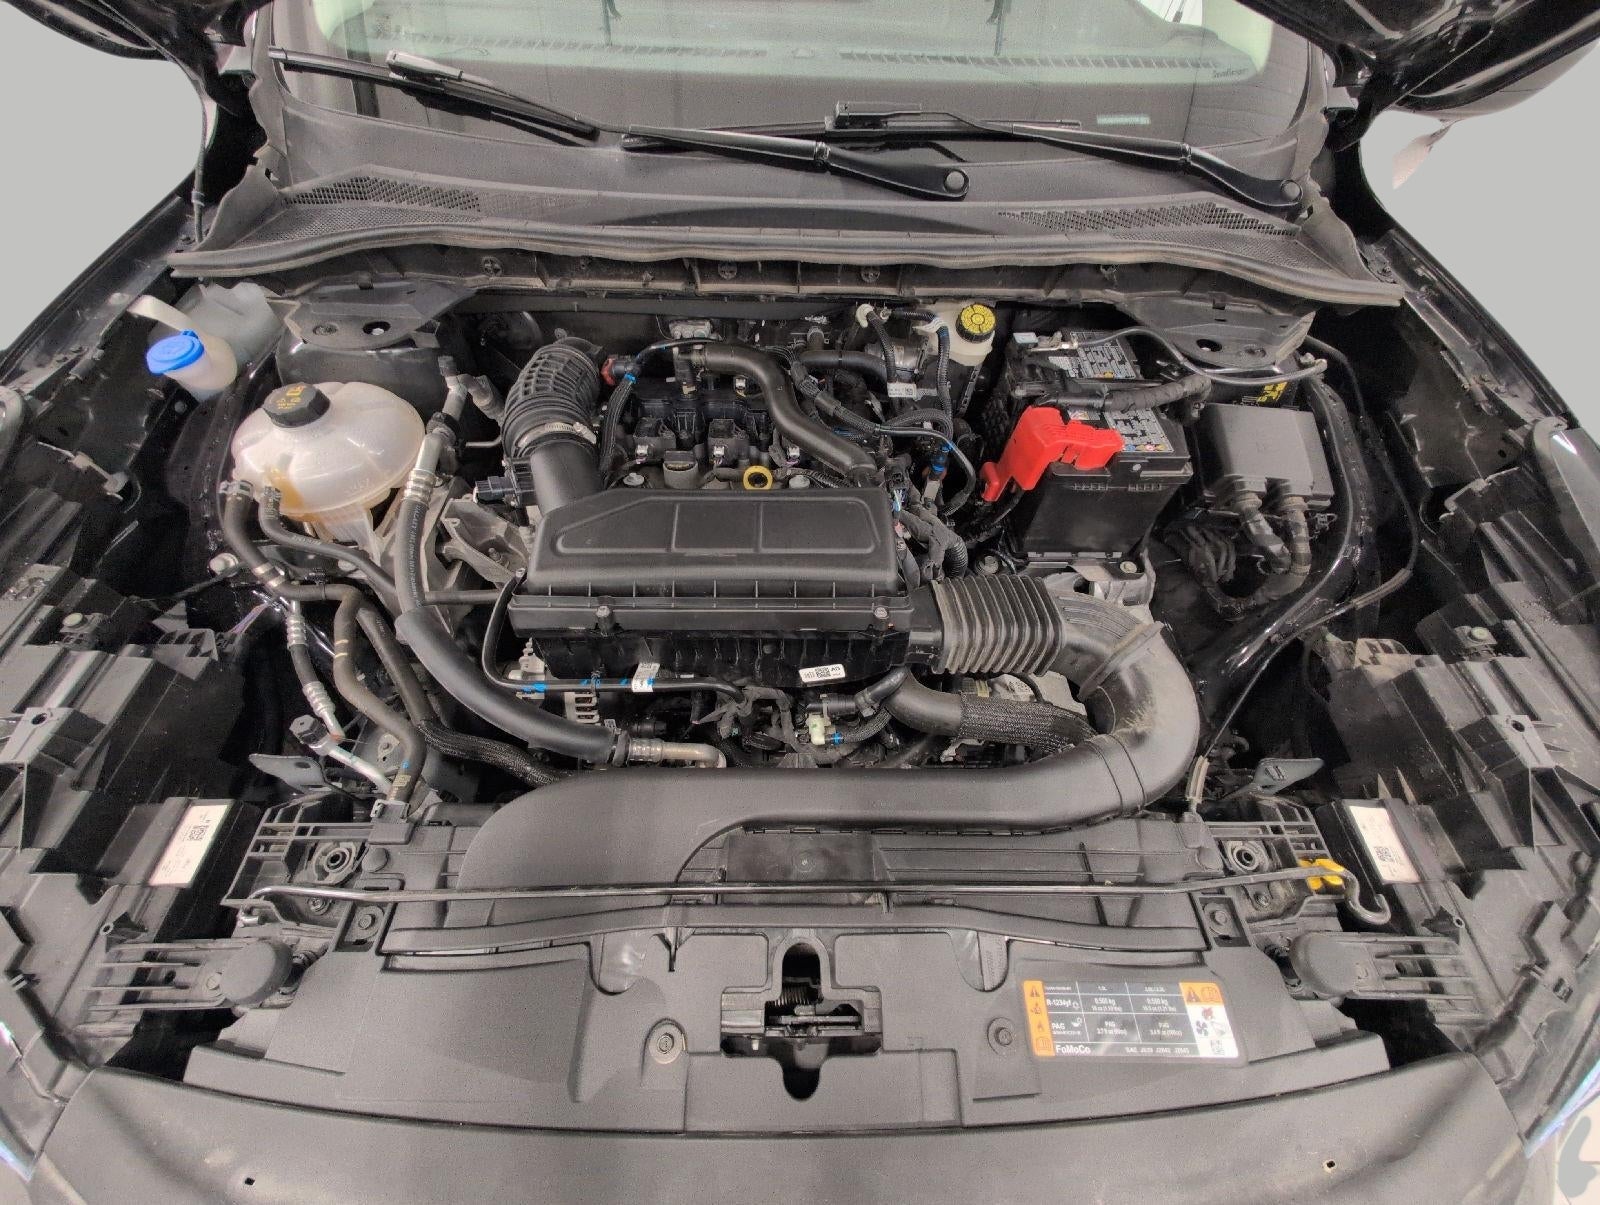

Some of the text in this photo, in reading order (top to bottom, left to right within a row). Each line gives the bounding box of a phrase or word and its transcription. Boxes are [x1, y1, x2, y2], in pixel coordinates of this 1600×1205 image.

[1046, 999, 1072, 1008] R-1234yf
[1052, 1022, 1066, 1030] PAG
[1056, 1045, 1092, 1053] FoMoCo
